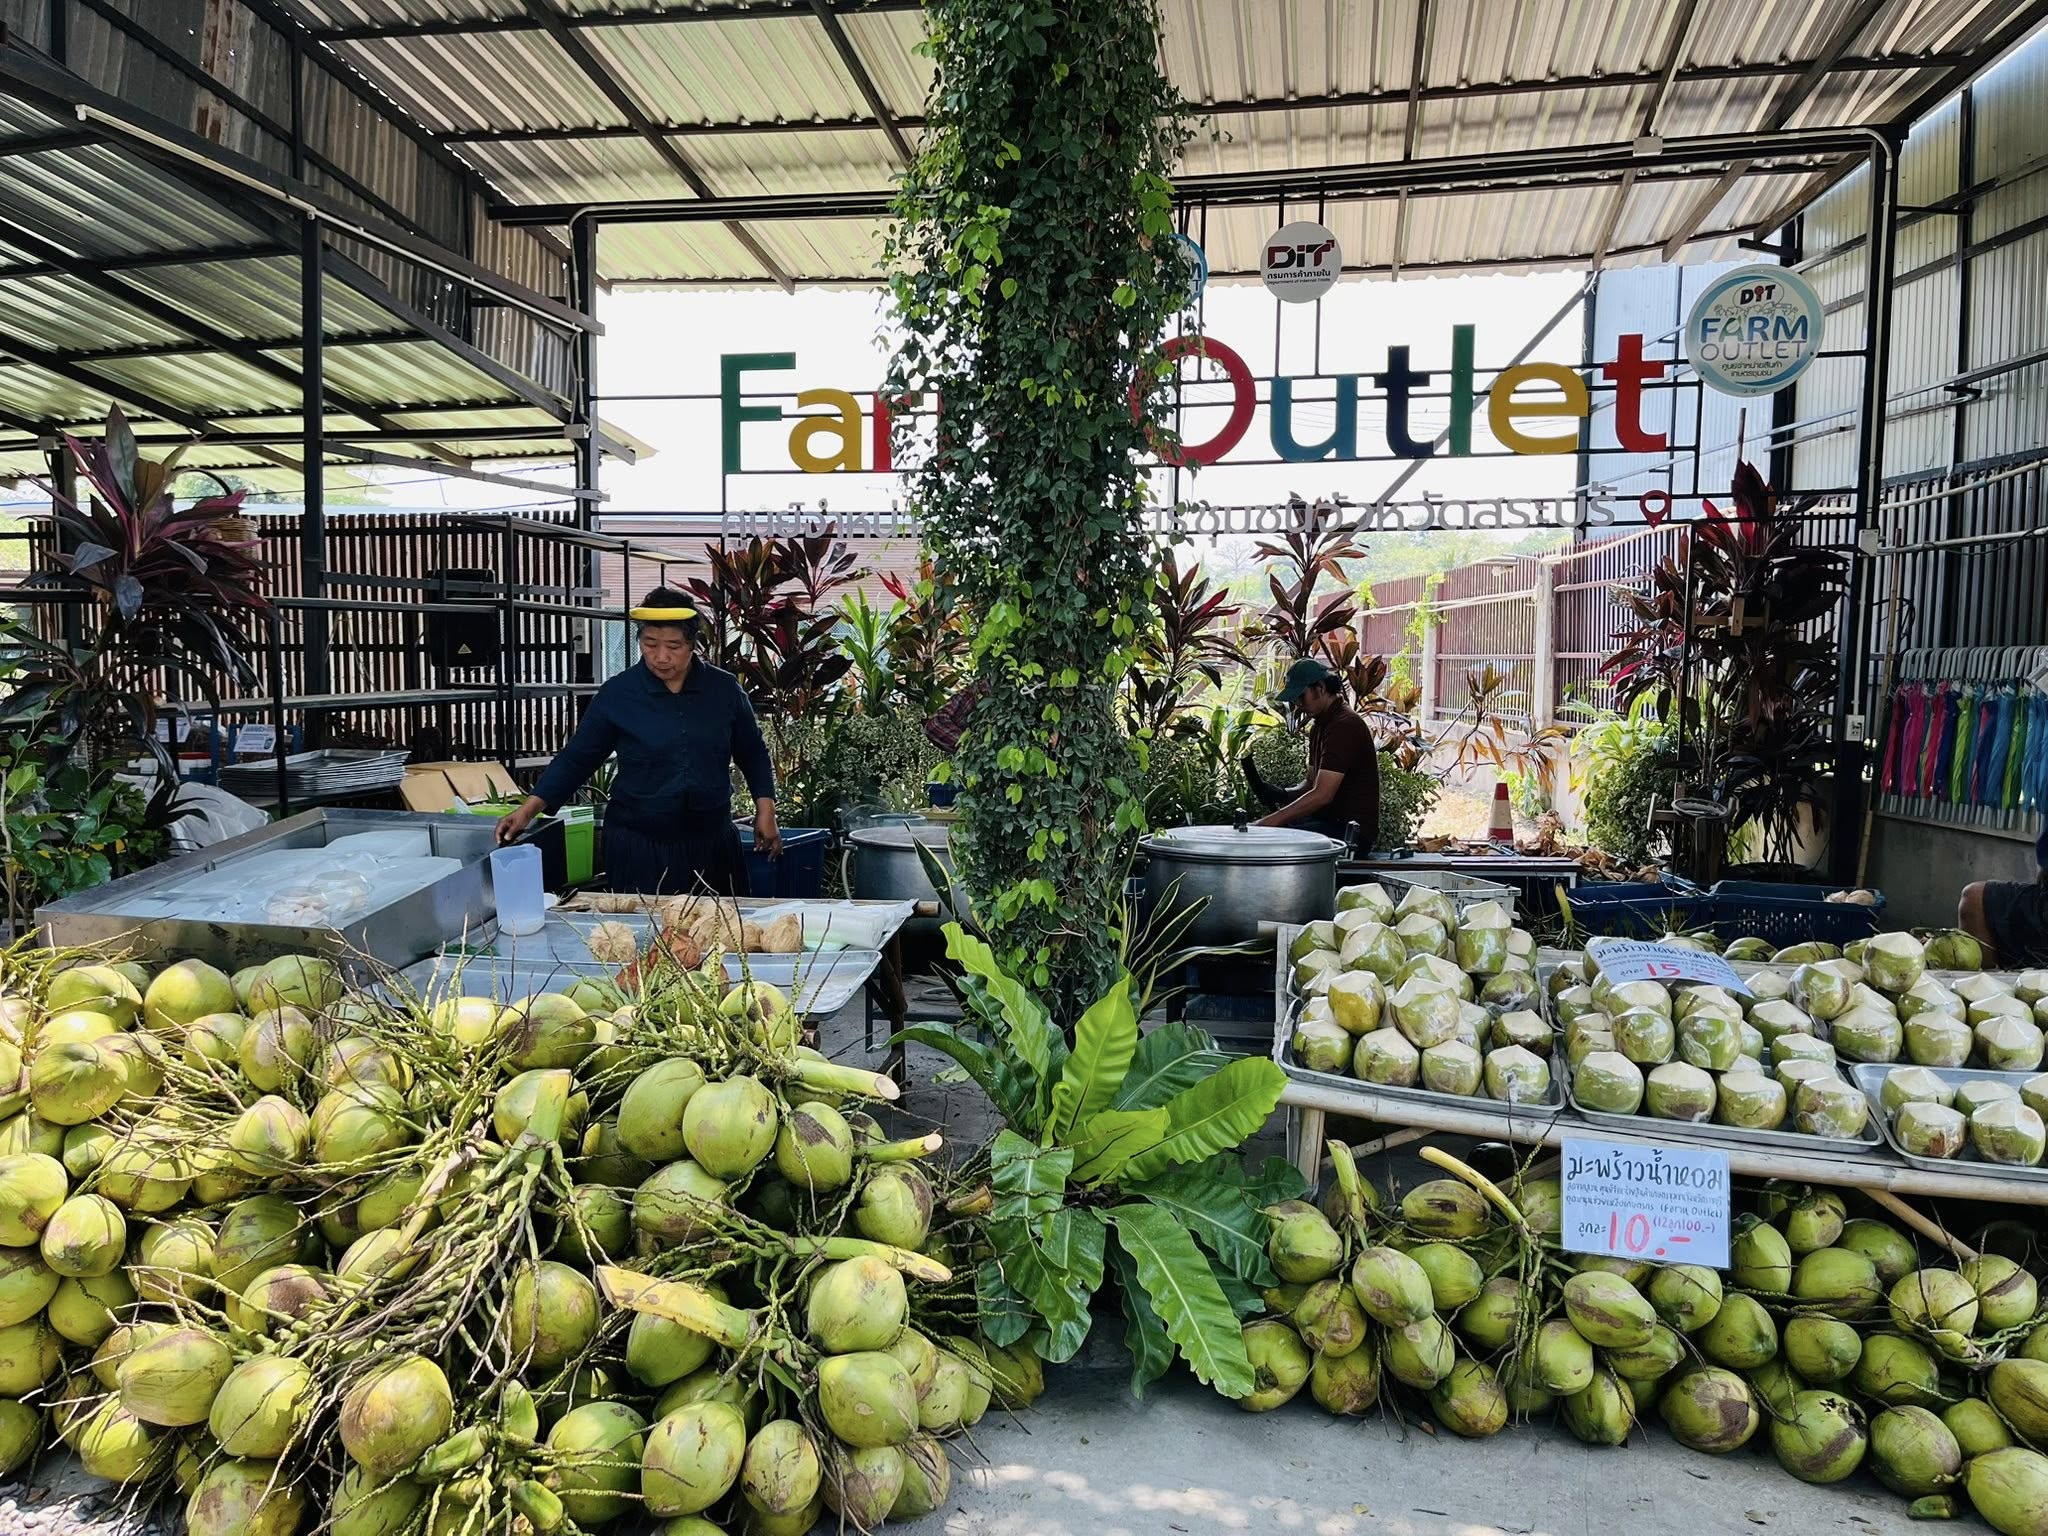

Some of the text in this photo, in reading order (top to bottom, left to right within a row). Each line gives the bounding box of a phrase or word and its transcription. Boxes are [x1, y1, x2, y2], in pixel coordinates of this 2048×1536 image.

[1267, 269, 1331, 280] กรมการค้าภายใน
[1701, 315, 1808, 342] FARM
[1701, 340, 1808, 361] OUTLET
[721, 323, 1668, 474] Far Outlet
[1567, 1149, 1723, 1190] มะพร้าวน้ำหอม
